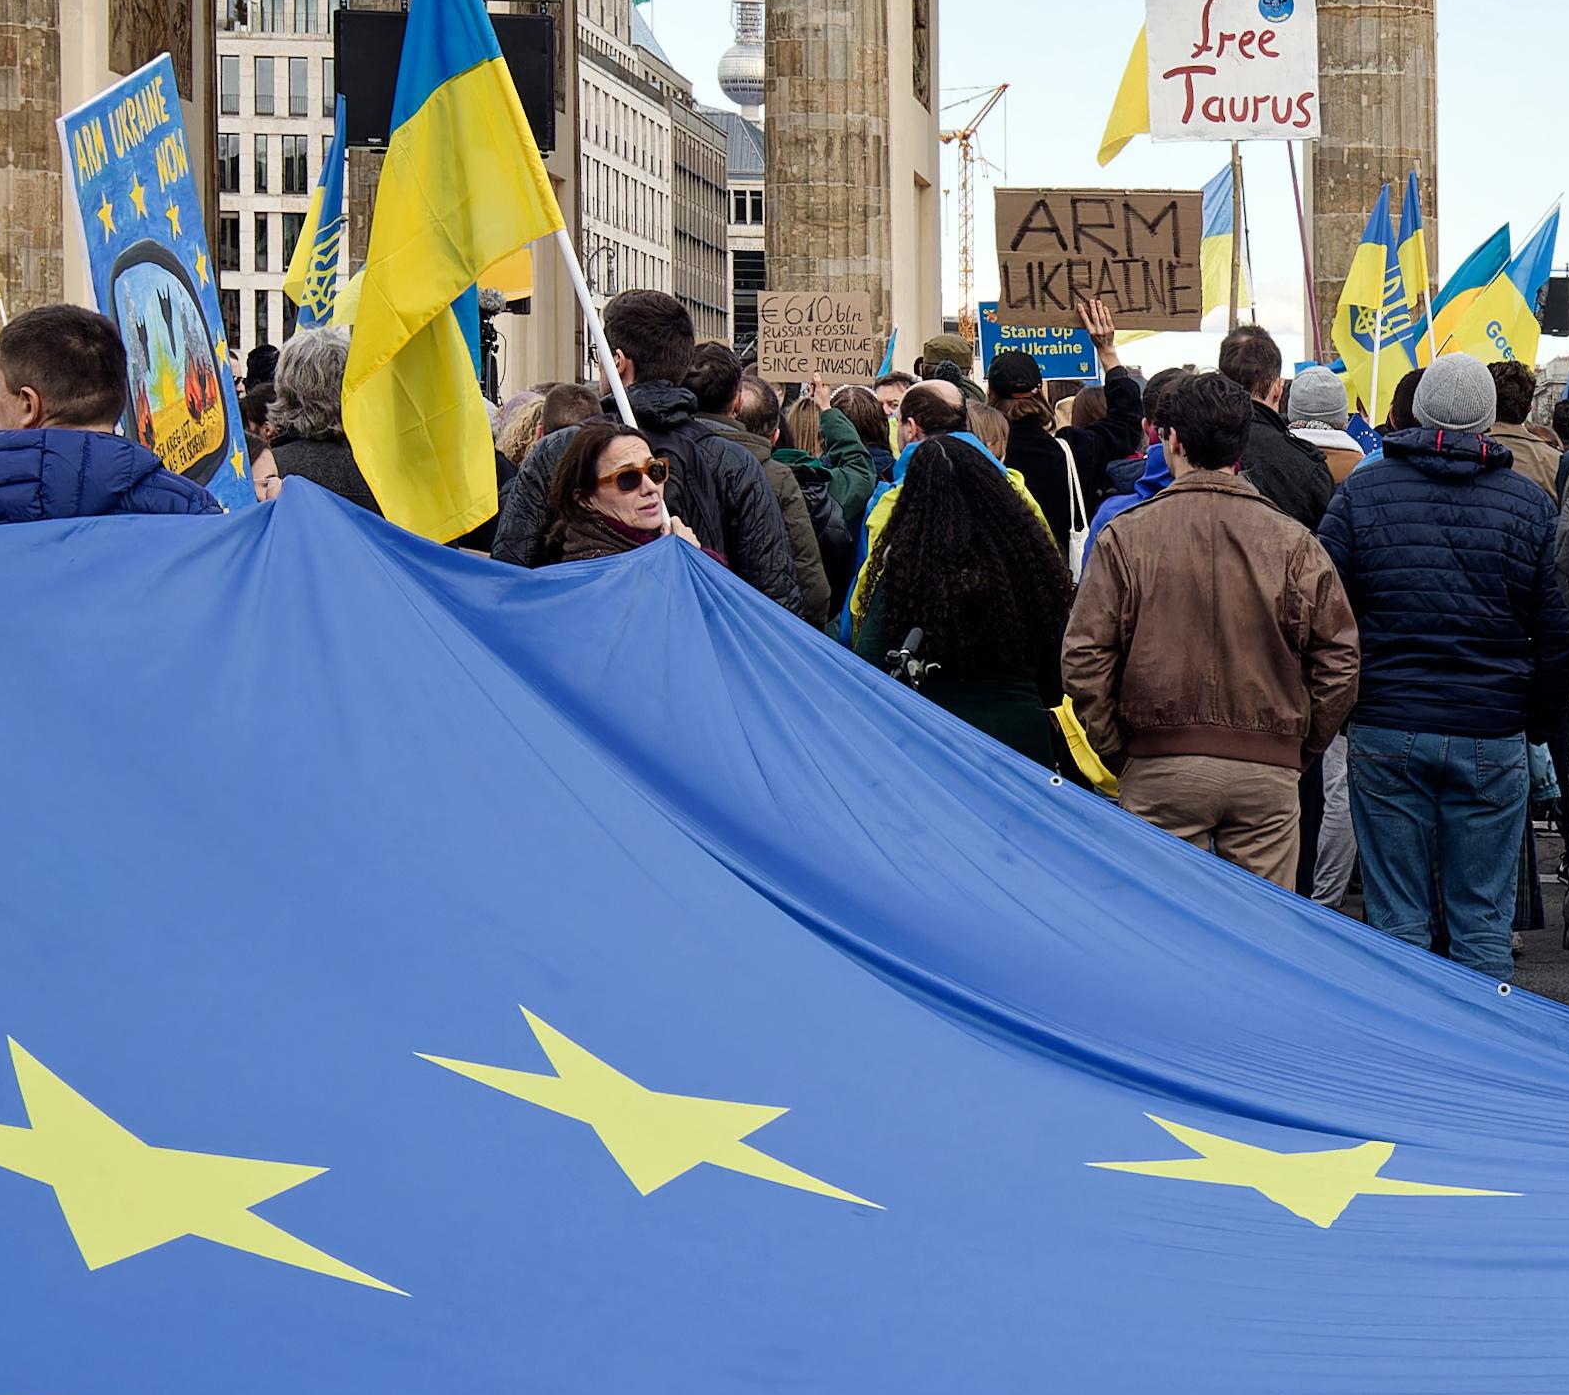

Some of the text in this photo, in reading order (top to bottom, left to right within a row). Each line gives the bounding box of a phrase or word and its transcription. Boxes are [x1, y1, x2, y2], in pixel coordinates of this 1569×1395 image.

[1163, 65, 1315, 129] Taurus
[73, 76, 170, 187] ARM UKRAINE
[155, 127, 189, 194] NOW
[1010, 194, 1181, 258] ARM
[1002, 256, 1199, 317] UKRAINE
[761, 295, 863, 325] €610 bln
[763, 324, 858, 339] RUSSIA'S FOSSIL
[764, 338, 872, 354] FUEL REVENUE
[1000, 325, 1047, 339] Stand
[1021, 341, 1083, 356] Ukraine
[813, 356, 873, 377] INVASION
